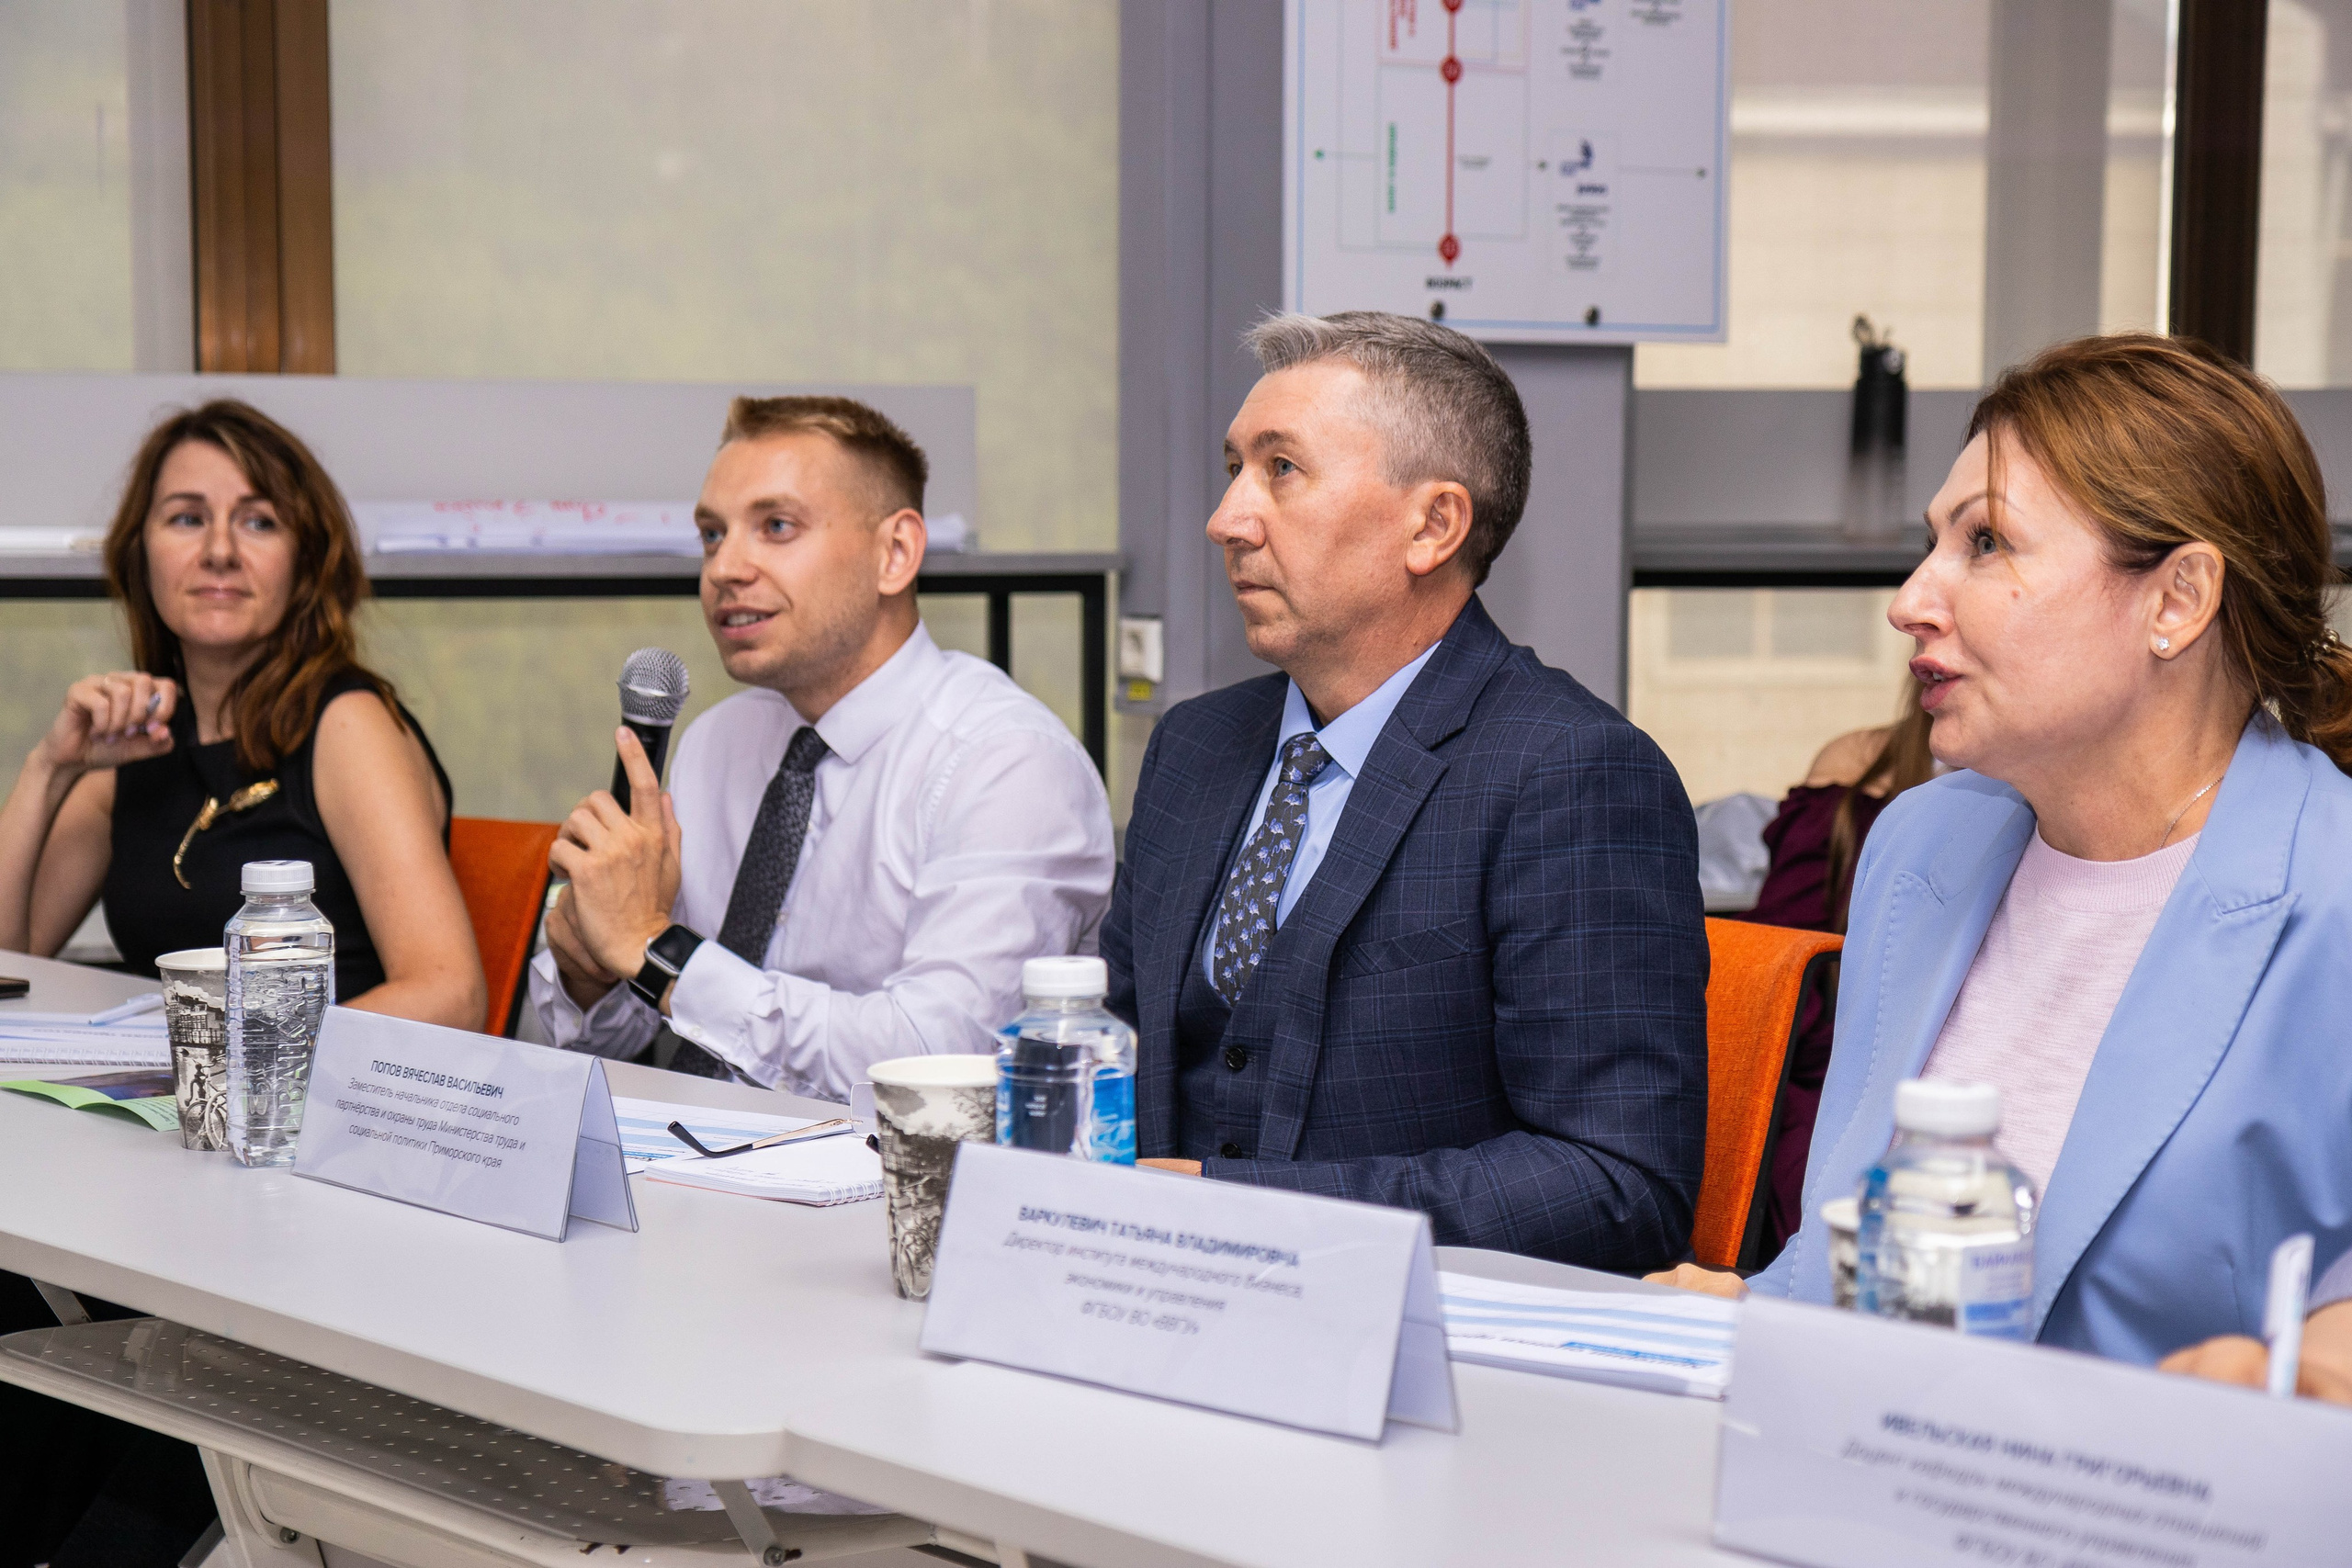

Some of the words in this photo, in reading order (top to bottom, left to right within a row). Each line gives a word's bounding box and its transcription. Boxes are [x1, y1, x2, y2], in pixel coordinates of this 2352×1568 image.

[347, 1077, 394, 1098] Заместитель
[394, 1089, 439, 1108] начальника
[439, 1100, 468, 1114] отдела
[468, 1106, 520, 1126] социального
[370, 1059, 401, 1077] ПОПОВ
[402, 1066, 446, 1087] ВЯЧЕСЛАВ
[447, 1076, 504, 1100] ВАСИЛЬЕВИЧ
[334, 1099, 380, 1118] партнёрства
[379, 1110, 387, 1119] и
[387, 1111, 416, 1125] охраны
[415, 1116, 438, 1132] труда
[437, 1120, 494, 1144] Министерства
[494, 1134, 518, 1150] труда
[518, 1141, 526, 1151] и
[348, 1123, 393, 1142] социальной
[391, 1134, 428, 1151] политики
[427, 1140, 481, 1164] Приморского
[481, 1156, 503, 1168] края
[1002, 1229, 1066, 1256] Директор
[1066, 1246, 1126, 1268] института
[1129, 1257, 1241, 1288] международного
[1018, 1204, 1108, 1235] ВАРКУЛЕВИЧ
[1110, 1220, 1172, 1245] ТАТЬЯНА
[1174, 1233, 1300, 1268] ВЛАДИМИРОВНА
[1064, 1273, 1135, 1294] экономики
[1135, 1285, 1146, 1297] и
[1146, 1287, 1227, 1312] управления
[1080, 1300, 1127, 1322] ФГБОУ
[1127, 1308, 1150, 1327] ВО
